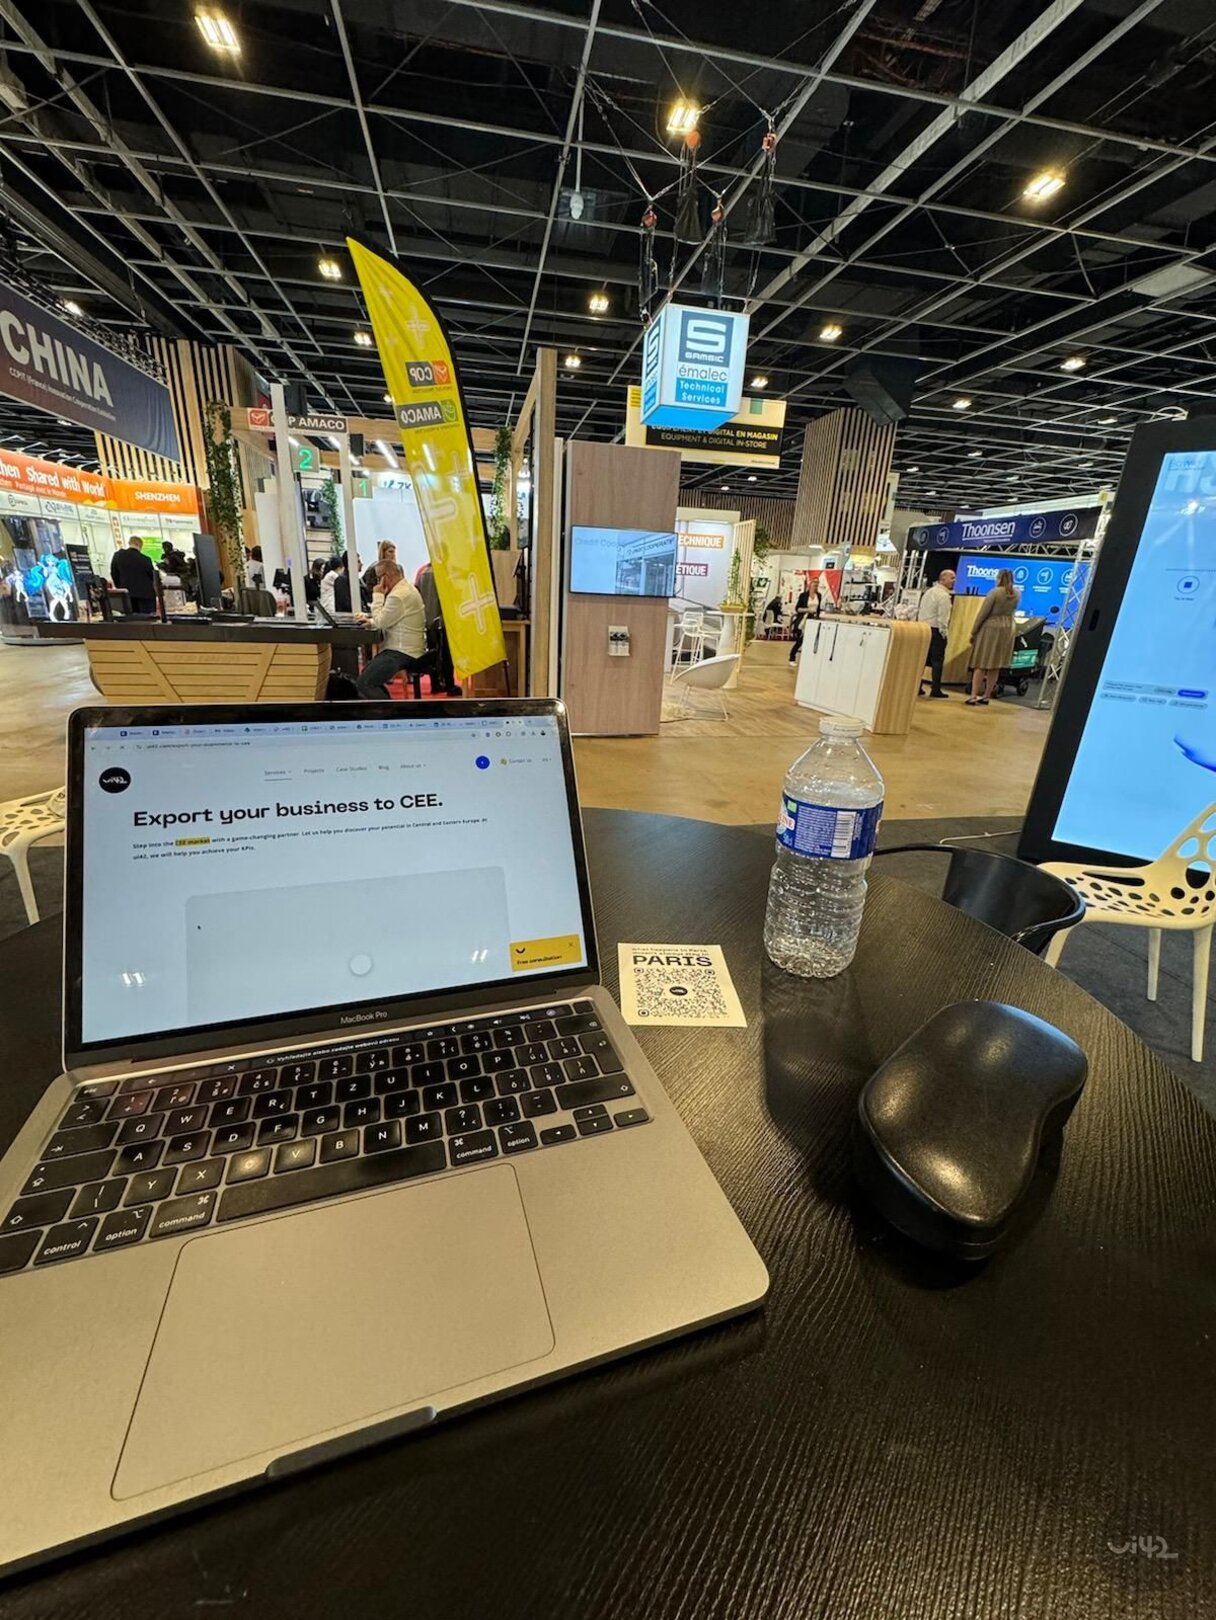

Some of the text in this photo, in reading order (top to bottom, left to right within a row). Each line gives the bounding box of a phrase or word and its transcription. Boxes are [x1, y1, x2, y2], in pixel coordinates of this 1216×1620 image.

[0, 310, 114, 408] CHINA
[678, 366, 728, 381] émalec
[680, 380, 725, 394] Technical
[682, 392, 721, 405] Services
[299, 417, 345, 430] AMACO
[746, 431, 778, 440] MAGASIN
[299, 447, 314, 470] 2
[0, 459, 21, 479] hen
[26, 465, 60, 488] Shared
[134, 491, 181, 503] SHENZHEN
[962, 521, 1016, 538] Thoonsen
[679, 535, 722, 548] ECHNIQUE
[676, 562, 707, 576] ÉTIQUE
[133, 793, 444, 829] Export your business to CEE.
[632, 955, 713, 967] PARIS
[340, 1011, 388, 1025] MacBook Pro
[507, 1136, 530, 1147] option
[456, 1145, 493, 1159] command
[158, 1212, 206, 1229] command
[105, 1227, 138, 1241] option
[43, 1240, 82, 1256] control
